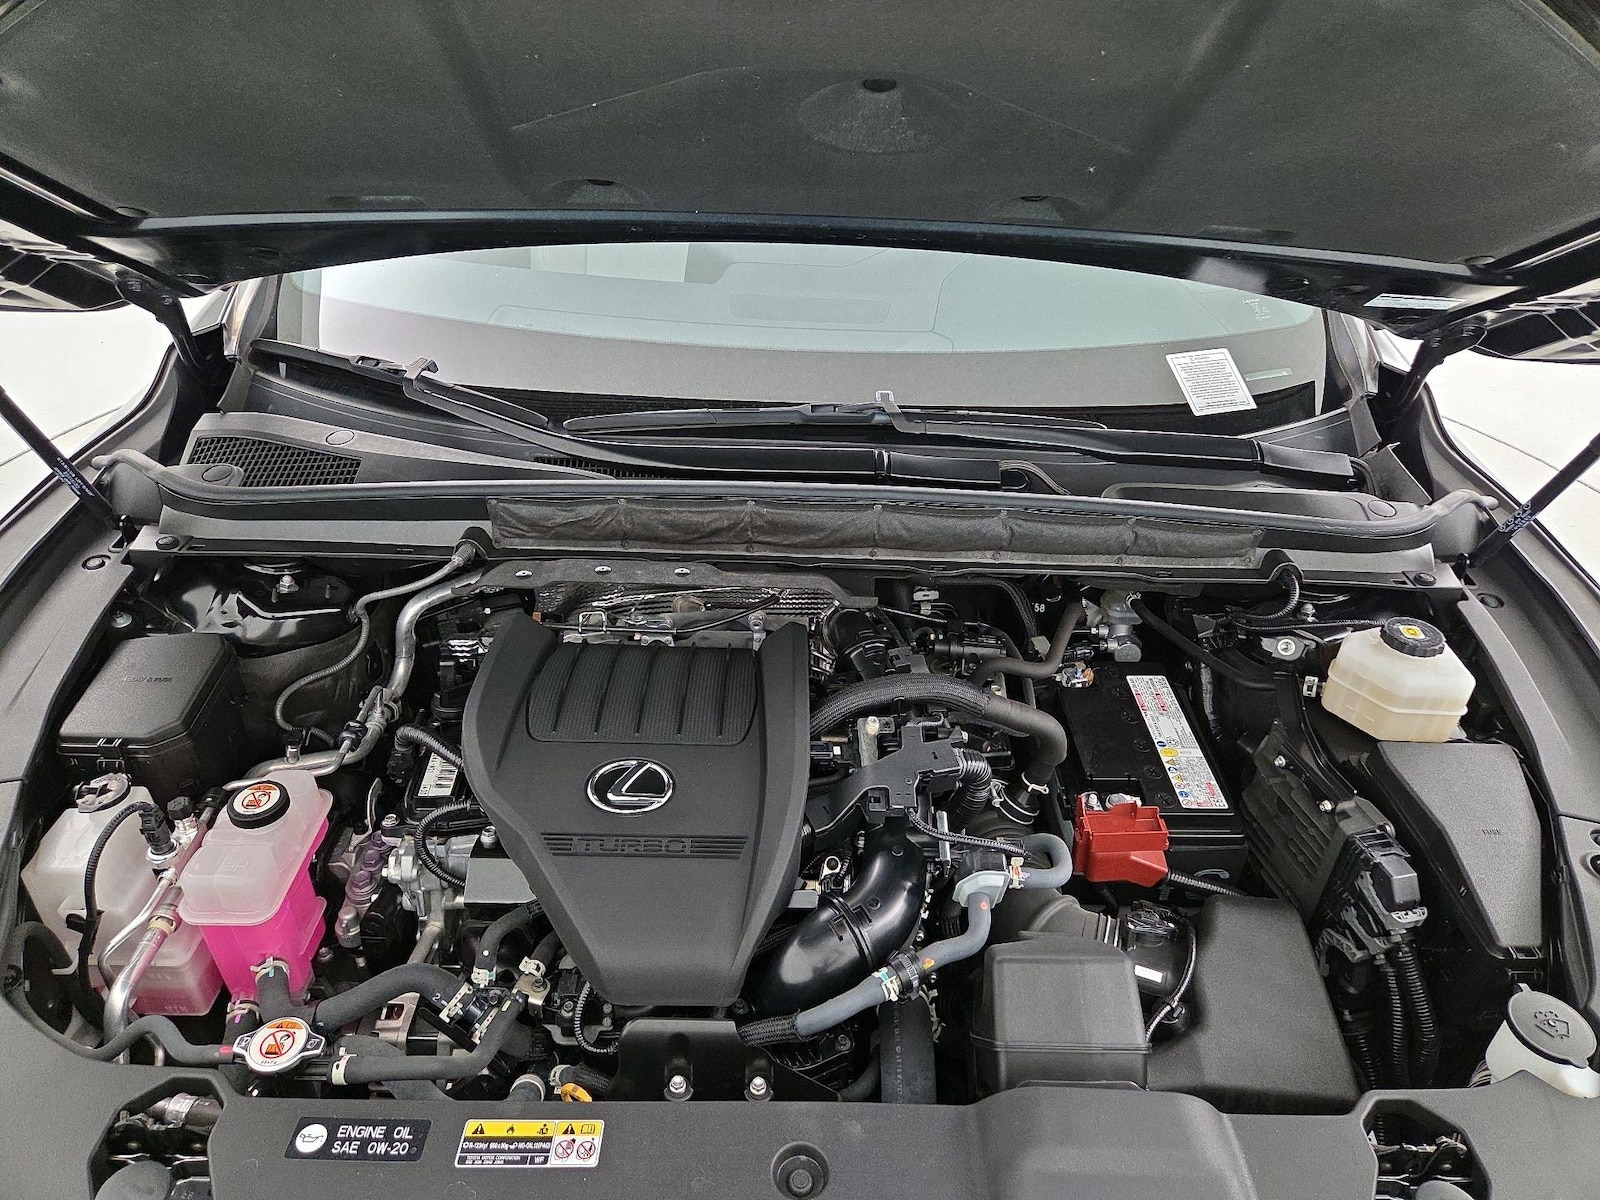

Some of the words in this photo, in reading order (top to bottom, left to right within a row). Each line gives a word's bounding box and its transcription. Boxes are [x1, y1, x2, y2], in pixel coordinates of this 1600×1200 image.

[1032, 602, 1045, 612] 58
[1481, 828, 1502, 836] FUSE
[576, 837, 687, 854] TURBO
[337, 1125, 387, 1139] ENGINE
[393, 1126, 413, 1139] OIL
[331, 1141, 360, 1154] SAE
[367, 1141, 409, 1155] 0W-20
